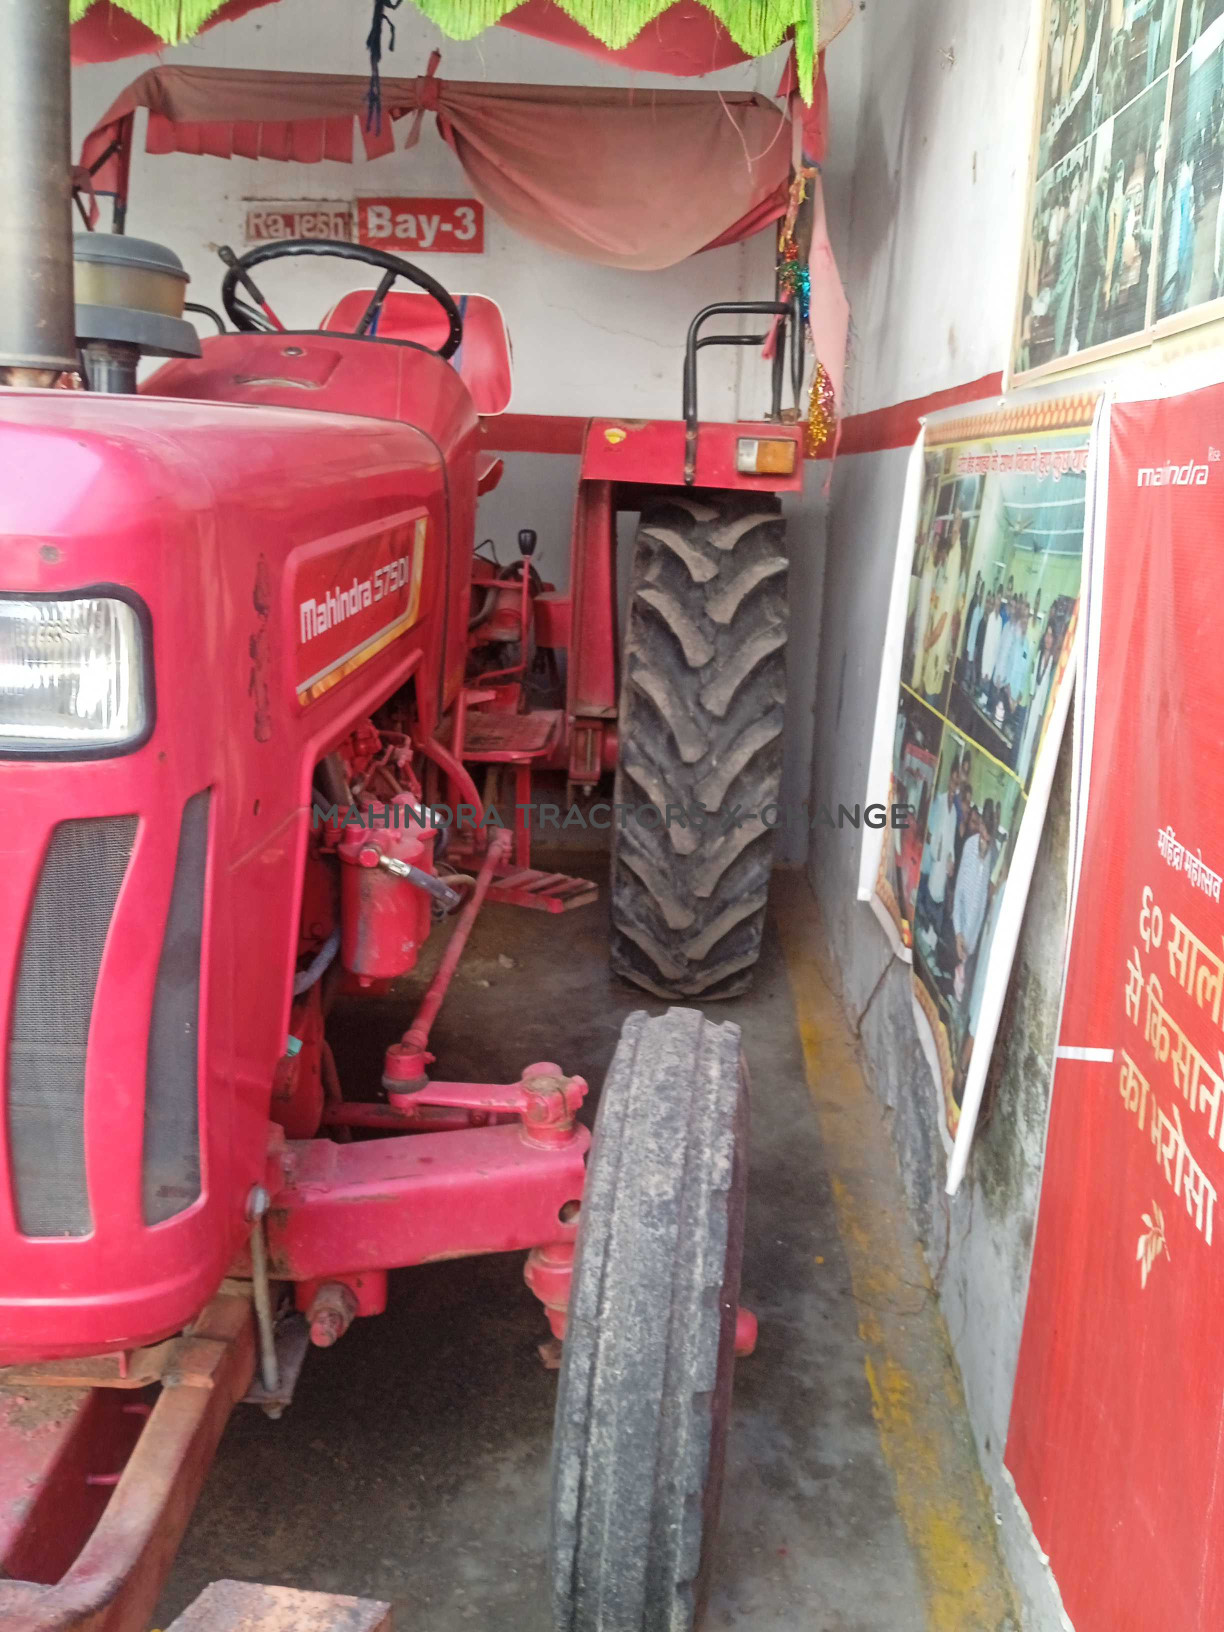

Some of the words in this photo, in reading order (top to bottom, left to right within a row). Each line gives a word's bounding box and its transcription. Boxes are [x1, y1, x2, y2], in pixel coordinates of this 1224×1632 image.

[367, 205, 478, 248] Bay-3
[1137, 459, 1209, 487] maindra
[300, 577, 373, 644] Mahindra
[1125, 945, 1145, 1026] से
[1119, 1048, 1150, 1131] का
[1151, 1093, 1218, 1247] भरोसा
